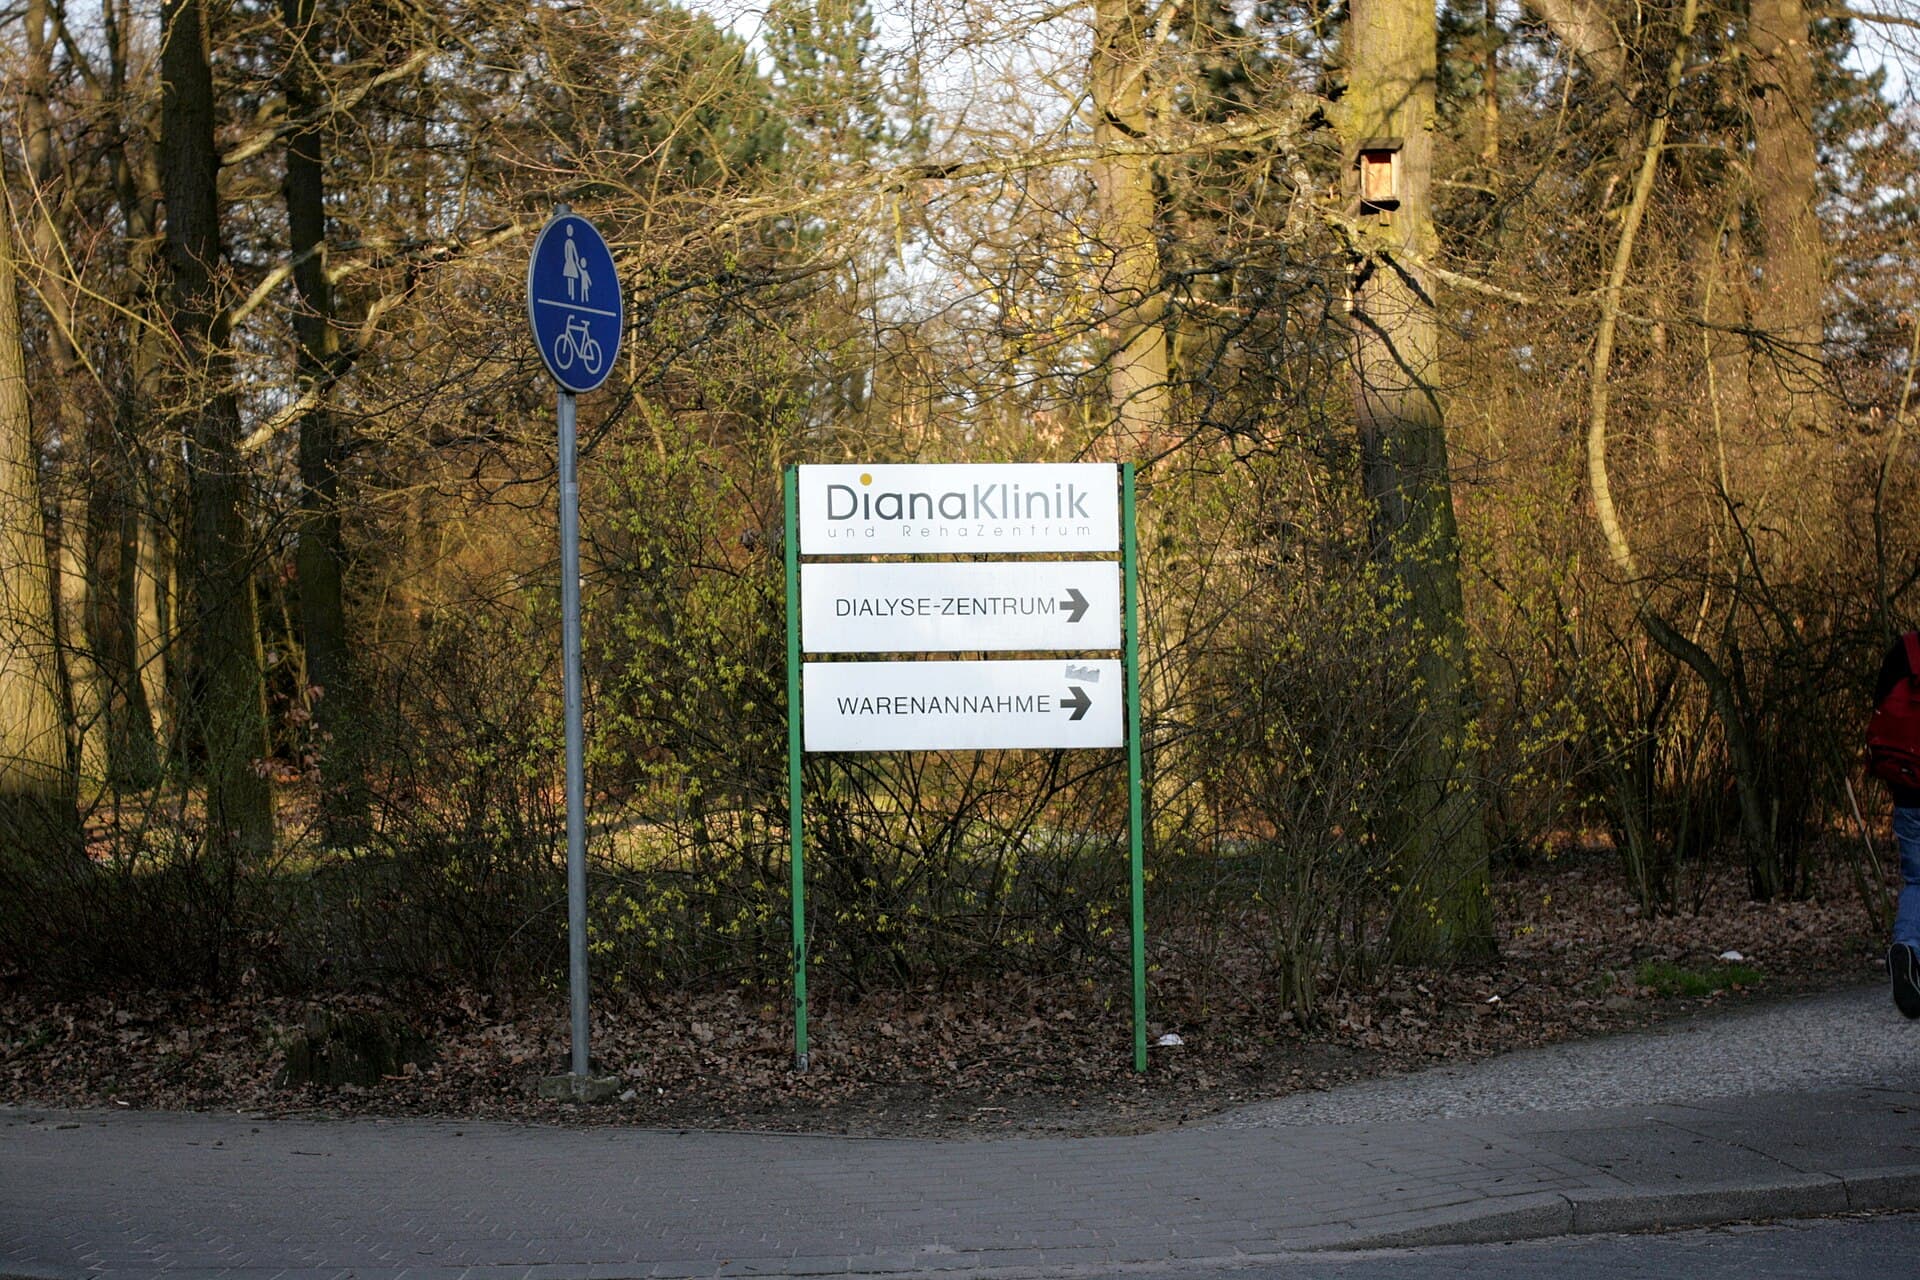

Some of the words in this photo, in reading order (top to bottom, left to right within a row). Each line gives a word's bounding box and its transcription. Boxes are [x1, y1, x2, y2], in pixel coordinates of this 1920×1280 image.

[827, 473, 1090, 520] DianaKlinik
[828, 525, 875, 538] und
[902, 524, 1091, 538] RehaZentrum
[836, 596, 1055, 616] DIALYSE-ZENTRUM
[837, 695, 1051, 715] WARENANNAHME
